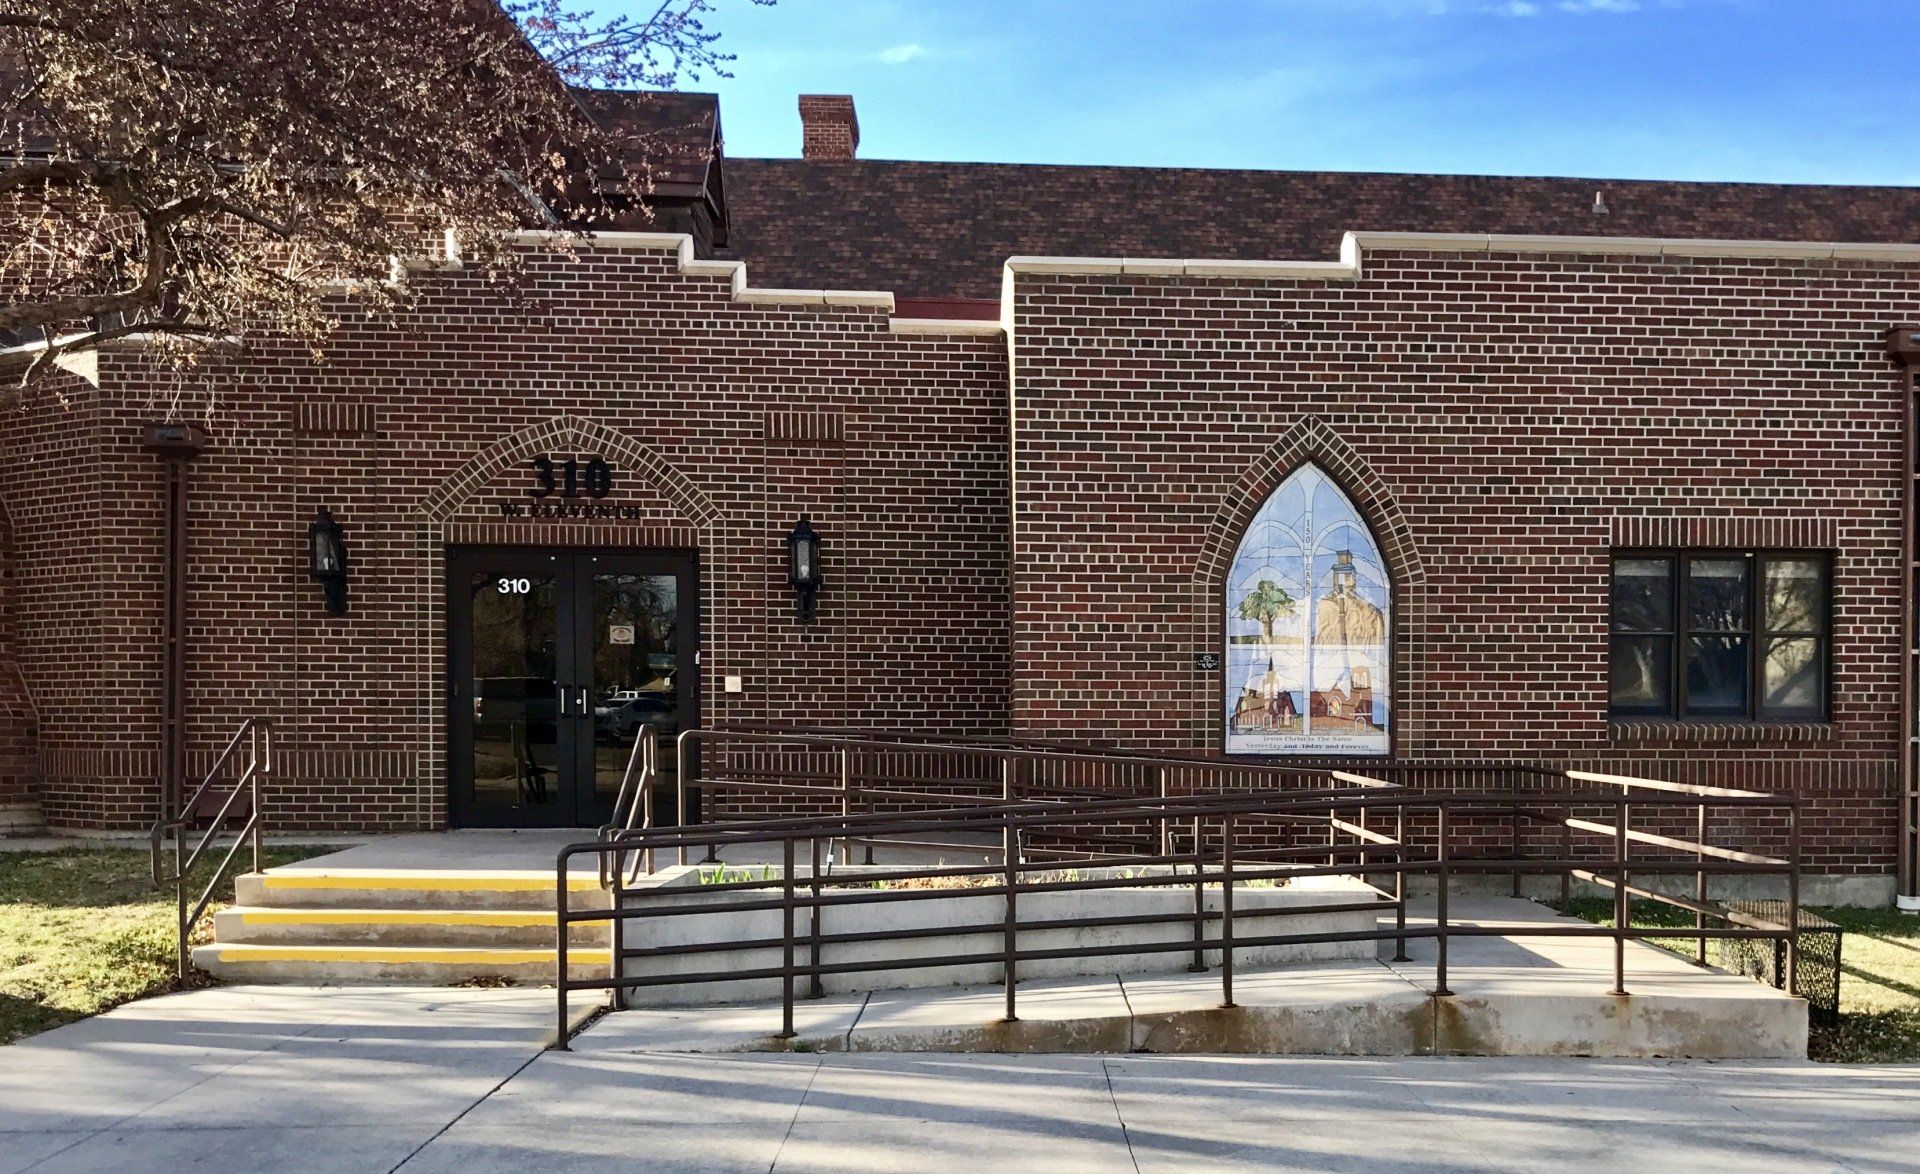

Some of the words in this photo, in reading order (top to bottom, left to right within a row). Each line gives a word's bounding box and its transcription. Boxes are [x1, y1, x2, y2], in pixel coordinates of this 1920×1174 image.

[530, 457, 611, 498] 310
[500, 503, 521, 518] W.
[531, 503, 640, 519] ELEVENTH
[497, 578, 530, 594] 310
